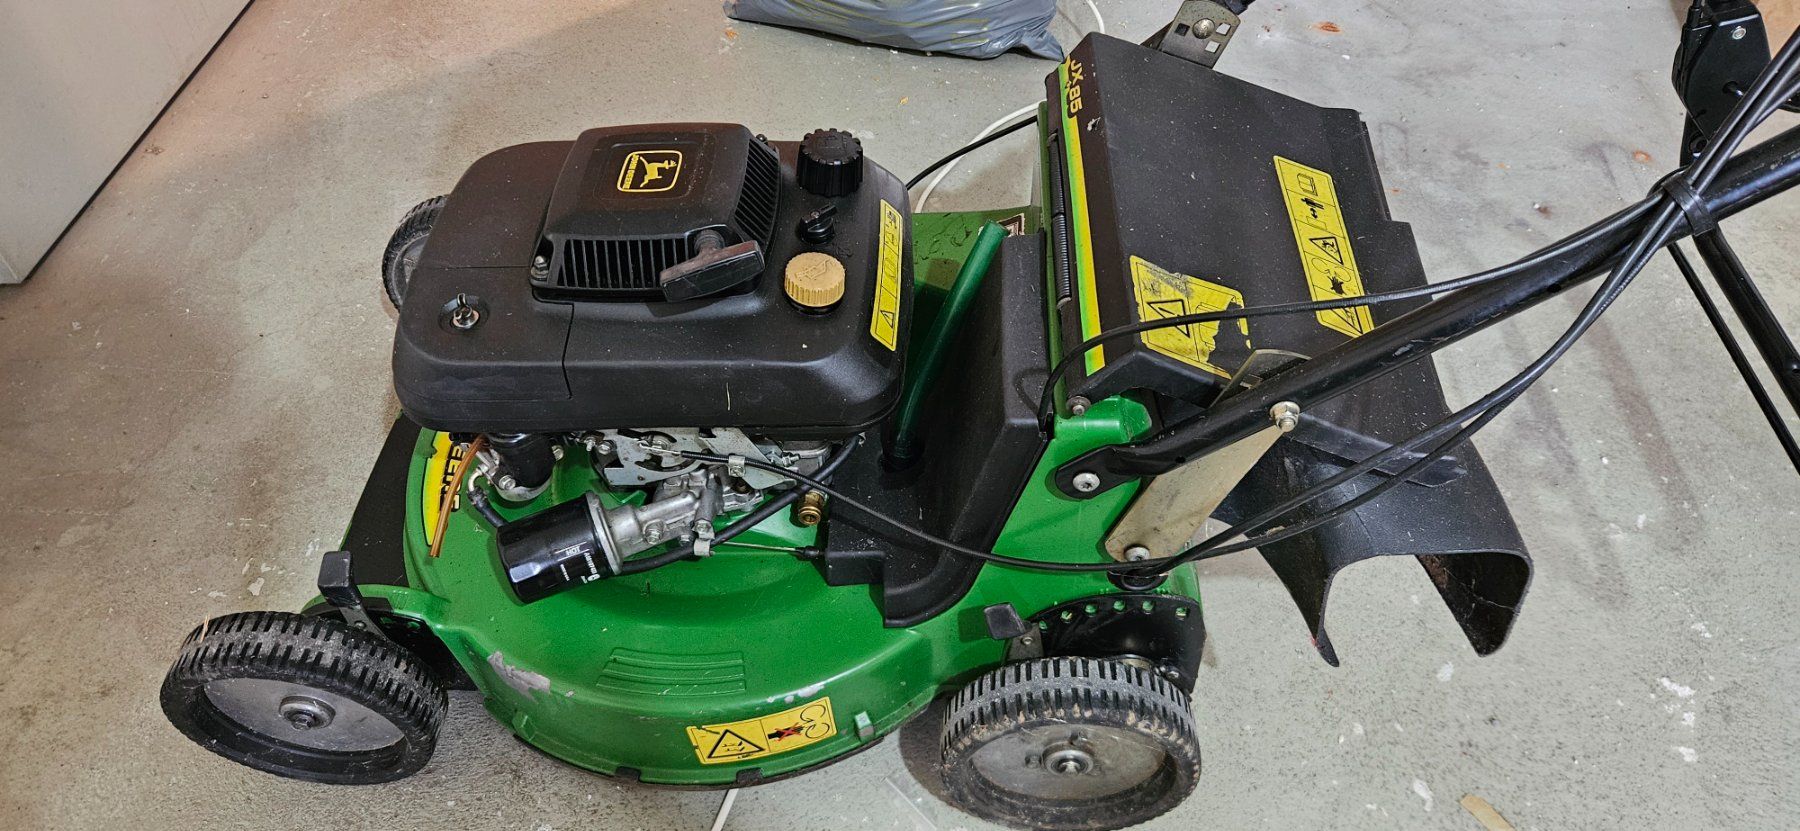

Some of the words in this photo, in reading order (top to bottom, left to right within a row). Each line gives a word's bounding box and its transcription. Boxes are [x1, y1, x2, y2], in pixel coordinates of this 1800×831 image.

[1070, 60, 1083, 85] JX
[1069, 85, 1082, 113] 85
[629, 154, 639, 170] JOHN
[622, 169, 635, 189] DEERE
